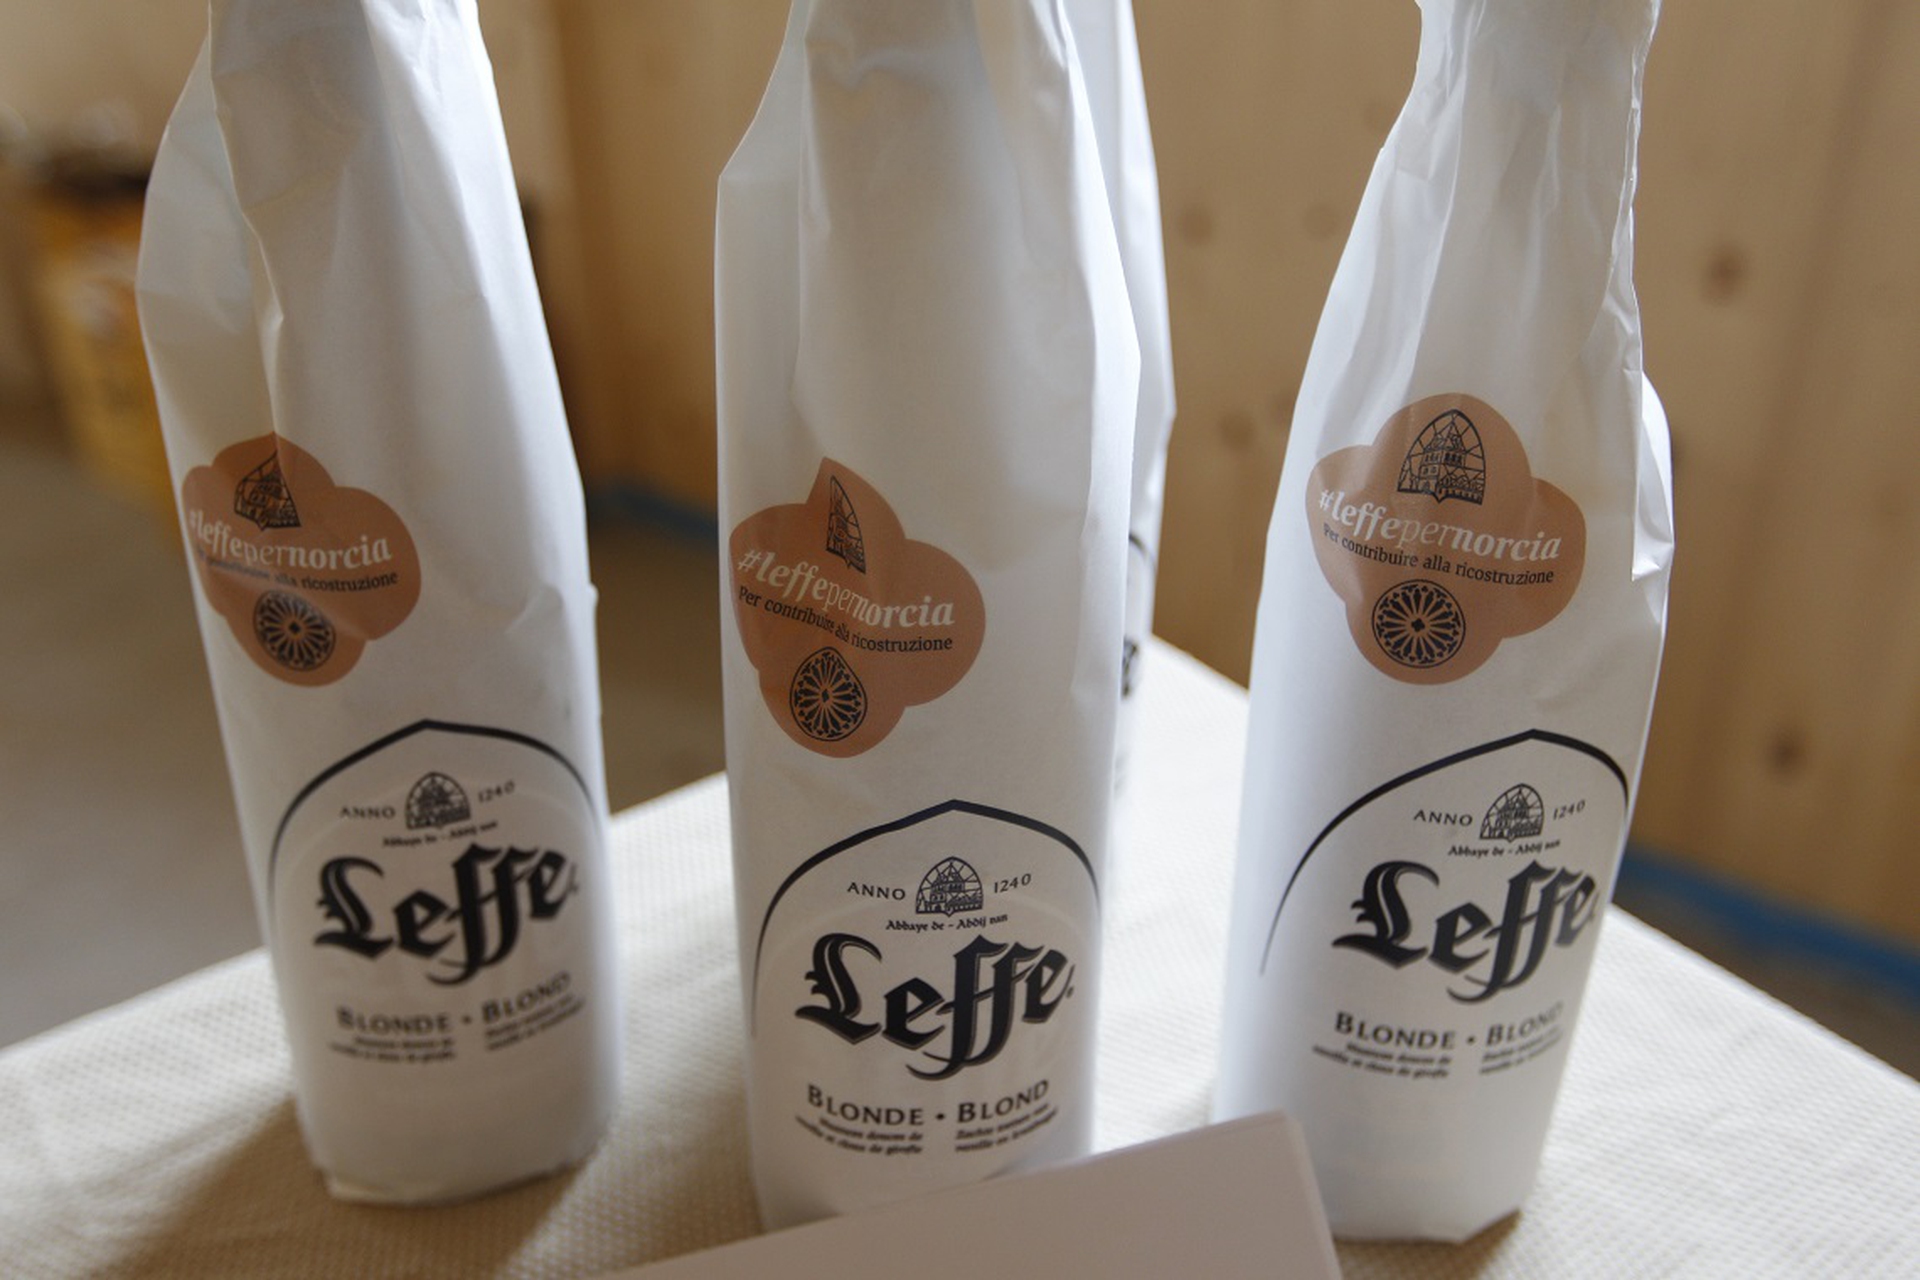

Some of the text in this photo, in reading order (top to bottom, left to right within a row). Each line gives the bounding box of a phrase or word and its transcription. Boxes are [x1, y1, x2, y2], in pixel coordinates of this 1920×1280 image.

[1318, 488, 1562, 562] #leffepernorcia
[1323, 522, 1554, 585] Per contribuire alla ricostruzione
[301, 570, 398, 593] ricostruzione
[737, 549, 956, 629] #leffepernorcia
[739, 585, 762, 608] Per
[764, 597, 836, 634] contribuire
[851, 632, 953, 653] ricostruzione
[340, 780, 516, 820] ANNO 1240
[1413, 800, 1586, 827] ANNO 1240
[847, 872, 1032, 900] ANNO 1240
[312, 843, 578, 988] Leffe
[885, 919, 928, 934] Abbaye
[931, 920, 945, 931] de
[1331, 859, 1600, 1005] Leffe
[795, 932, 1076, 1082] Leffe
[1334, 1010, 1455, 1049] BLONDE
[807, 1084, 924, 1126] BLONDE
[956, 1079, 1049, 1124] BLOND
